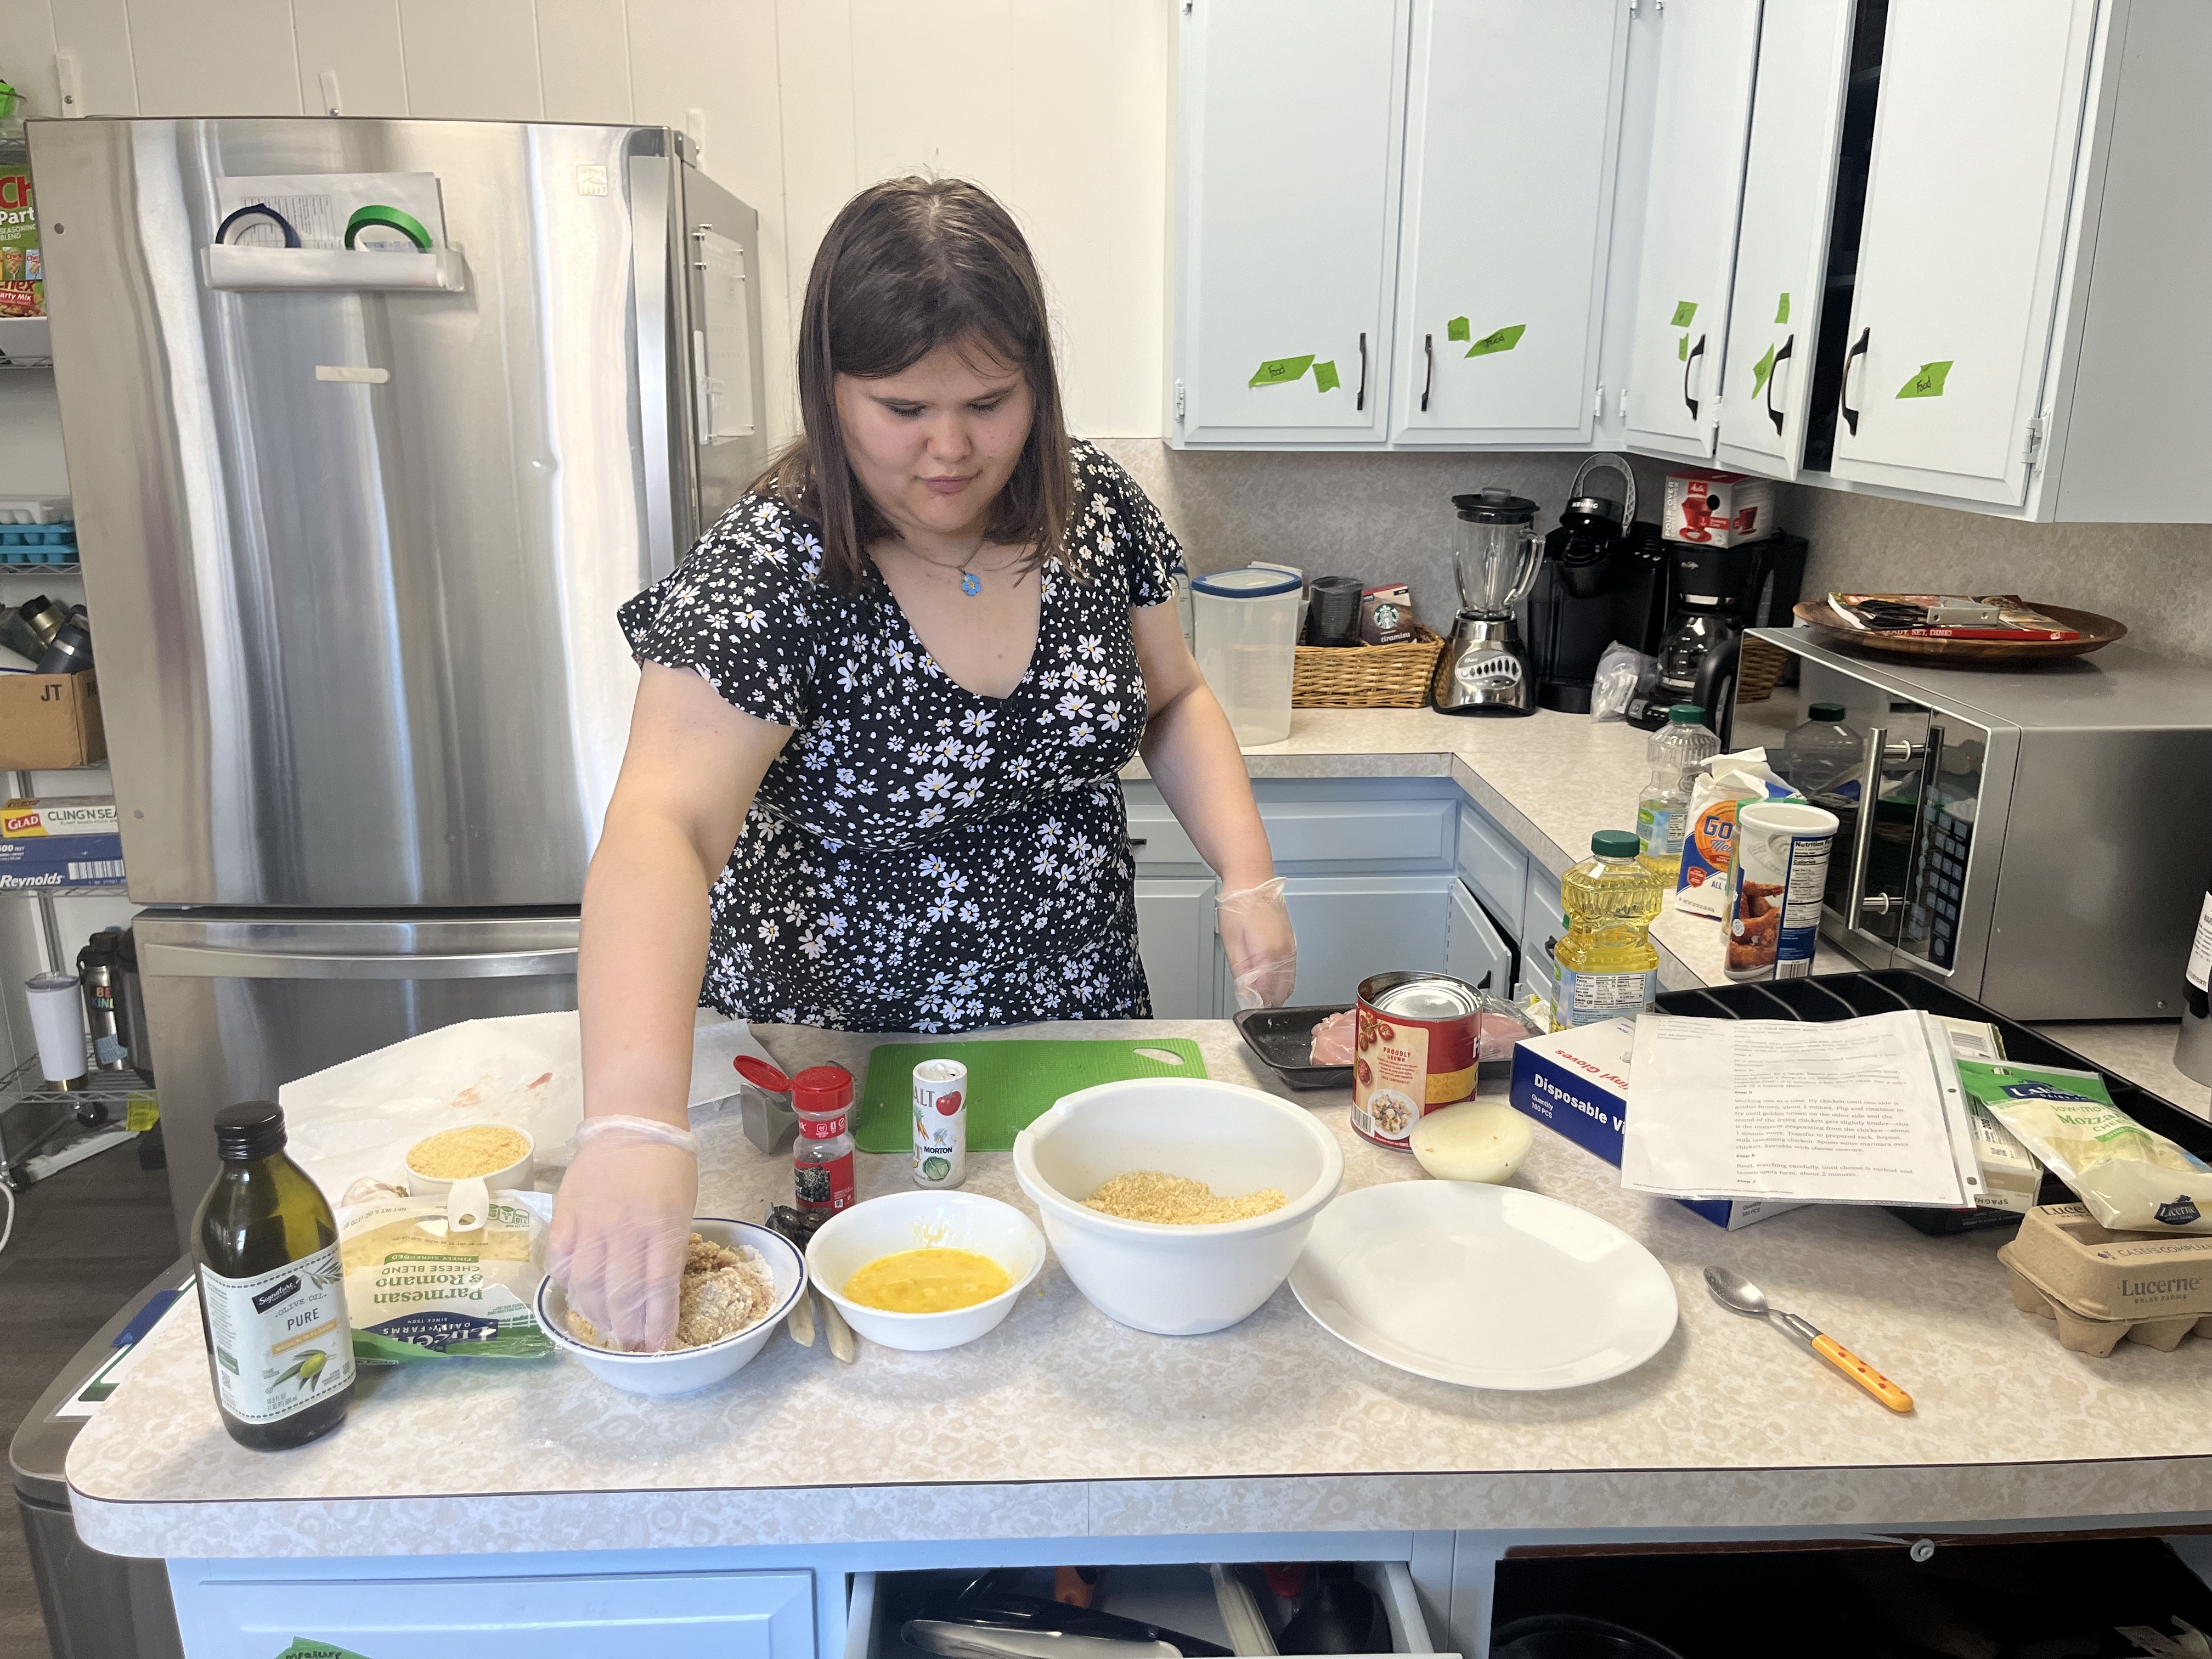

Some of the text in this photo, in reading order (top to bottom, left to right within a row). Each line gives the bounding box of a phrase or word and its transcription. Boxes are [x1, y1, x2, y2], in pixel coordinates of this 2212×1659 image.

[0, 233, 21, 241] BLEND
[1380, 632, 1411, 643] tiramisu
[41, 684, 63, 702] JT
[8, 815, 40, 831] GLAD
[0, 872, 63, 889] Reynolds
[1711, 881, 1723, 890] ALL
[97, 987, 112, 998] BE
[1383, 1046, 1411, 1058] PROUDLY
[1555, 1049, 1601, 1073] Gloves
[1531, 1093, 1554, 1111] Quantity
[1534, 1073, 1608, 1124] Disposable
[1531, 1102, 1553, 1119] 100 PCS
[1980, 1118, 1992, 1130] 200
[923, 1146, 953, 1154] MORTON
[1743, 1201, 1762, 1210] Quantity
[2159, 1204, 2197, 1217] Lucerne
[365, 1210, 374, 1218] OZ
[381, 1265, 425, 1275] BLEND
[375, 1273, 484, 1288] & Romano
[2121, 1277, 2201, 1297] Lucerne
[258, 1282, 294, 1306] Signature
[373, 1288, 484, 1304] Parmesan
[278, 1293, 324, 1316] OLIVE OIL
[287, 1307, 320, 1331] PURE
[382, 1322, 471, 1335] DAIRY FARMS
